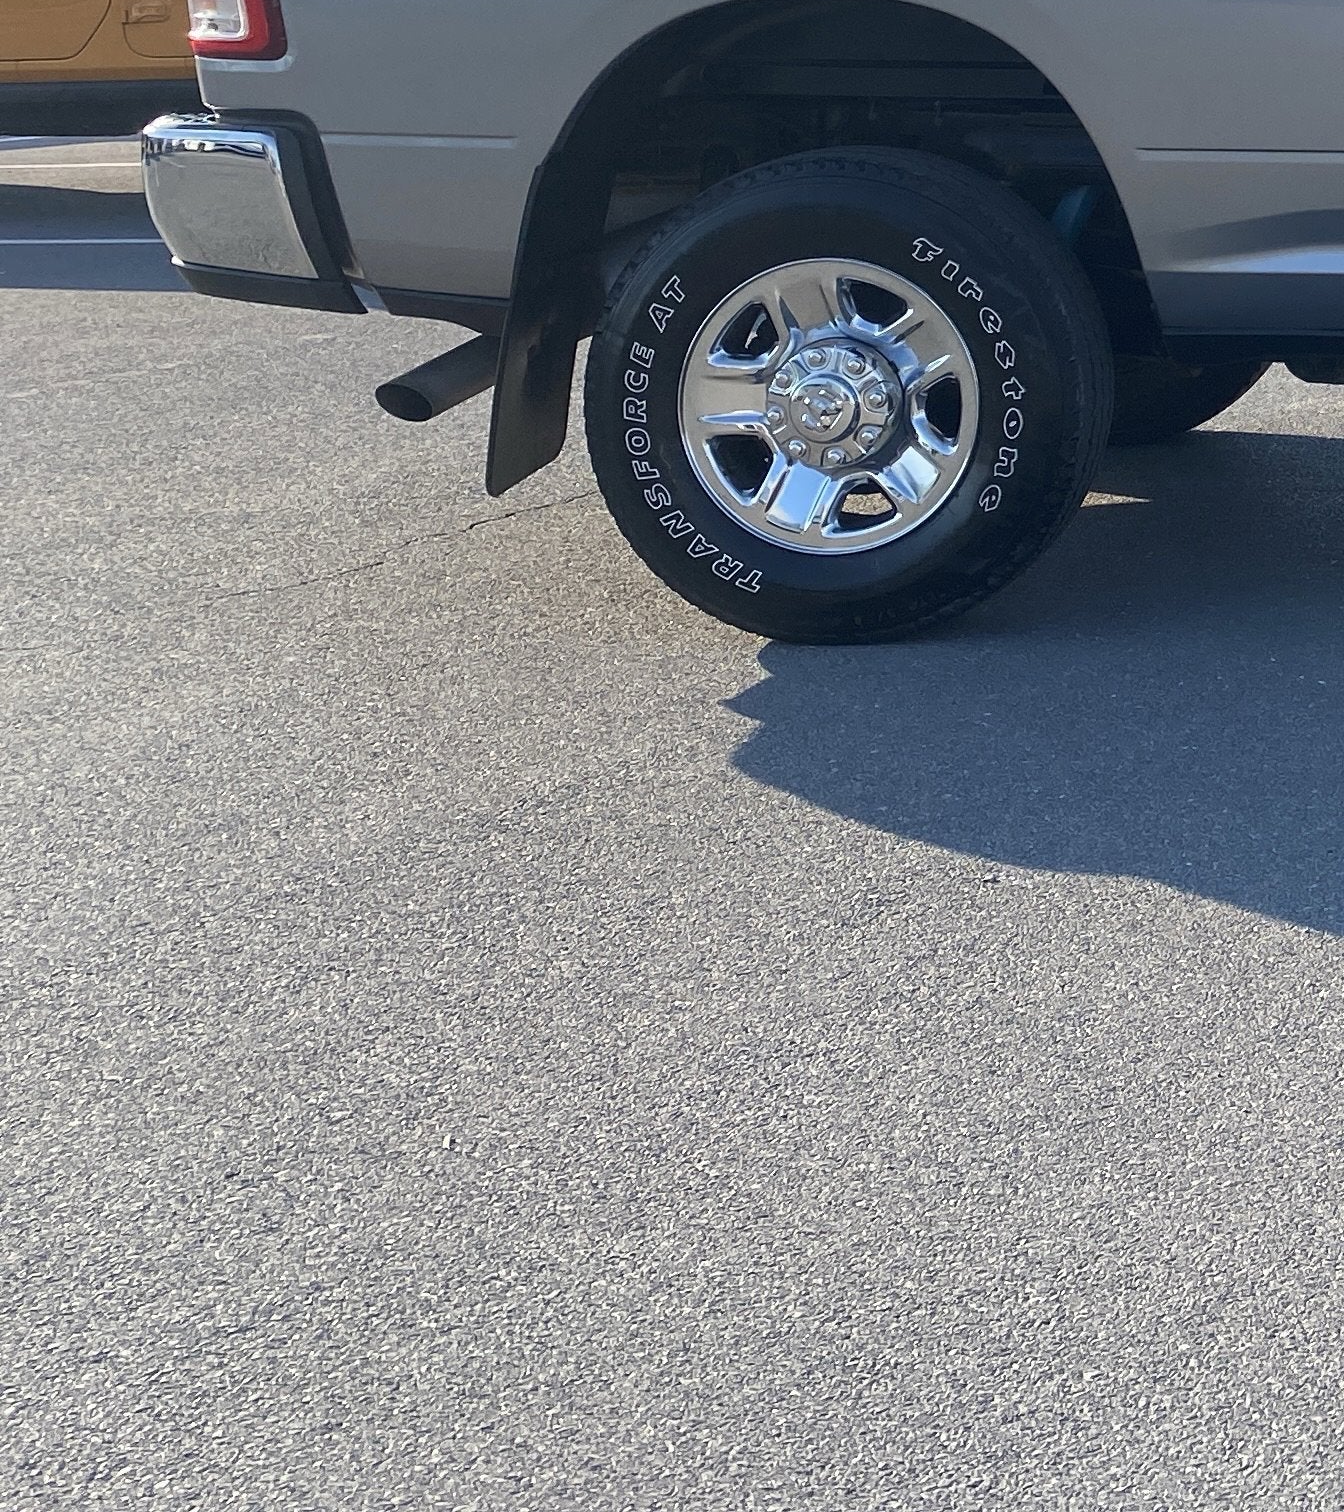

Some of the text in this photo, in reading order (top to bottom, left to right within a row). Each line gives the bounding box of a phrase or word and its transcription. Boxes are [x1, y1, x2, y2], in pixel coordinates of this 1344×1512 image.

[622, 275, 765, 593] TRANSFORCE AT
[912, 237, 1026, 514] Firestone
